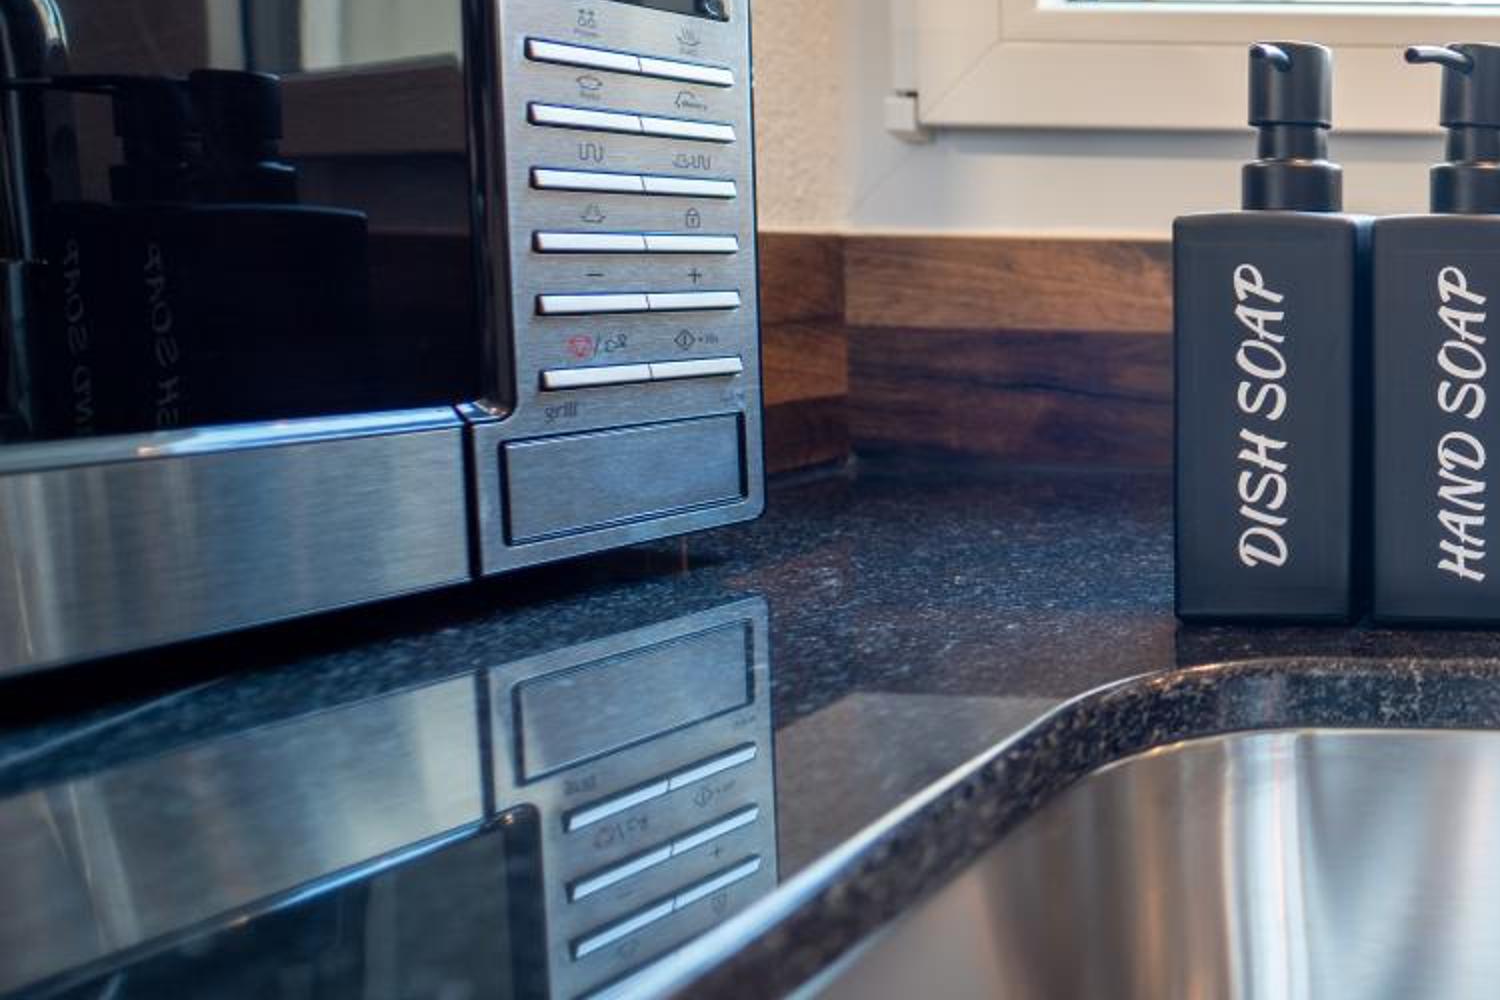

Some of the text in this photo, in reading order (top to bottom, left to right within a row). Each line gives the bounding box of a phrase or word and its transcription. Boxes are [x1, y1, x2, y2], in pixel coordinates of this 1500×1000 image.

[1234, 264, 1287, 566] DISH SOAP
[1437, 266, 1486, 581] HAND SOAP
